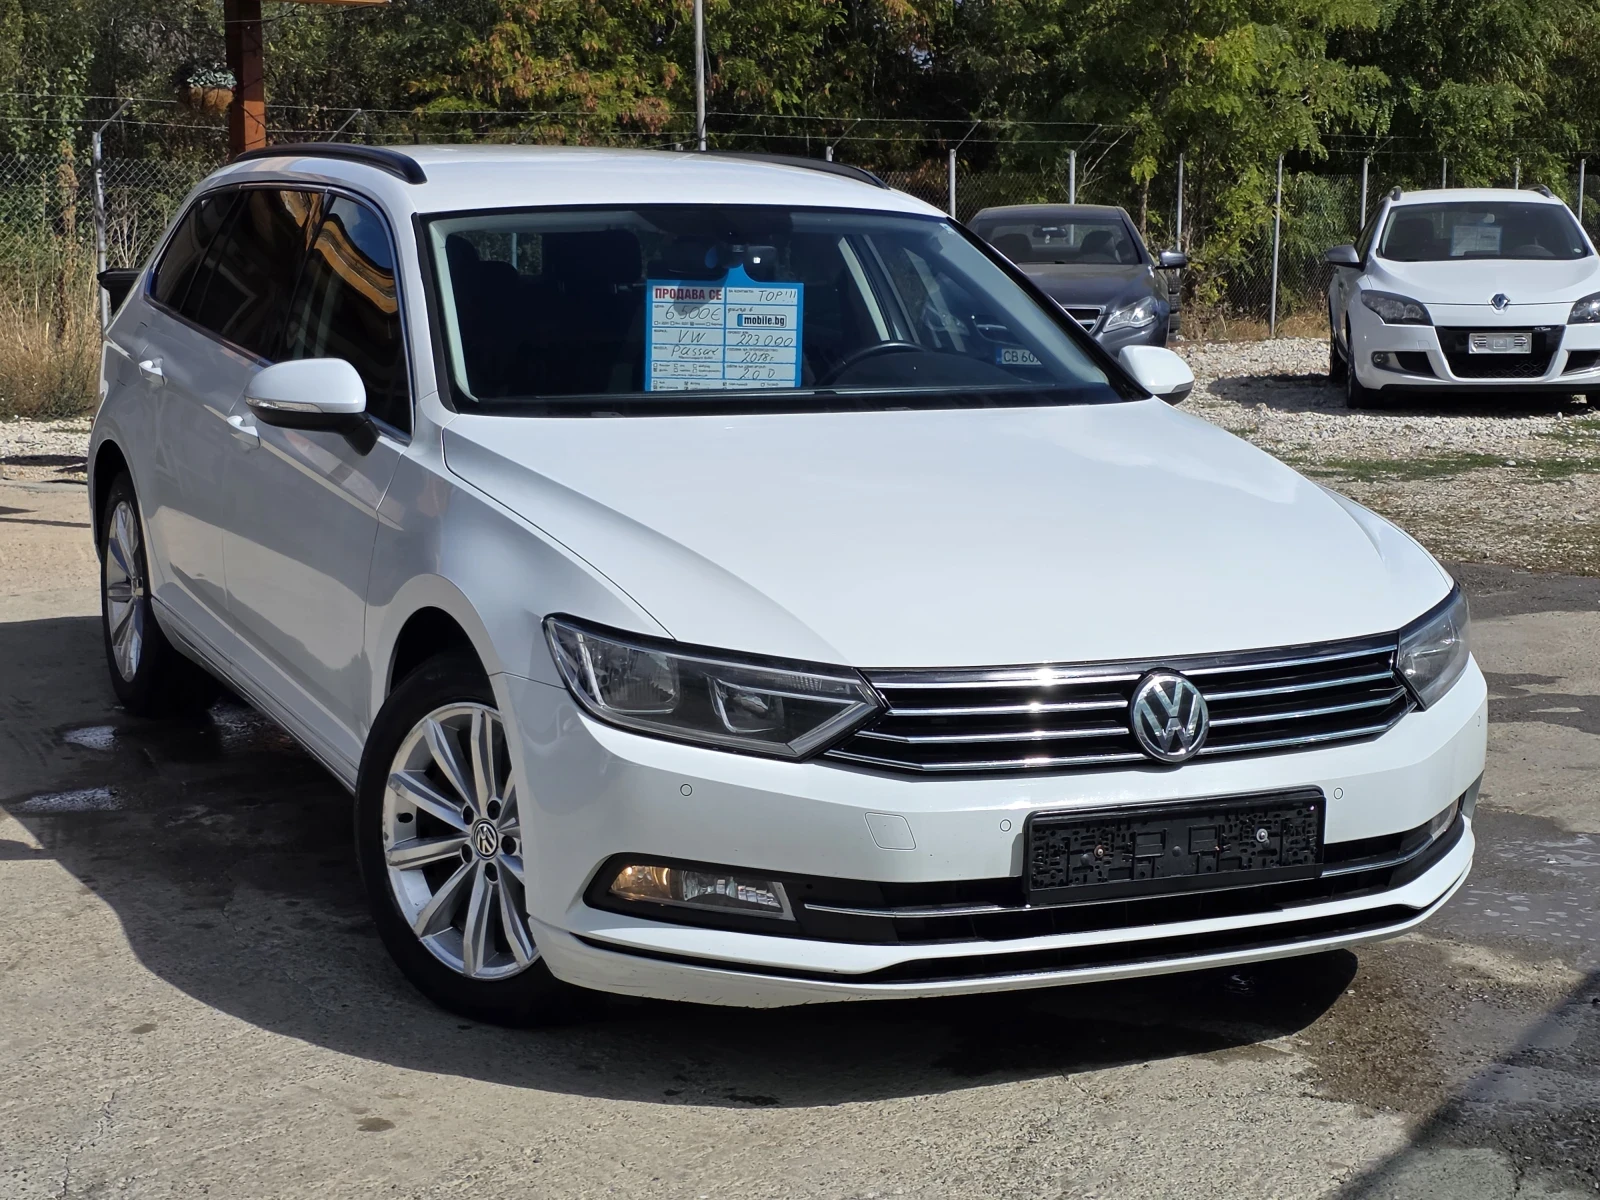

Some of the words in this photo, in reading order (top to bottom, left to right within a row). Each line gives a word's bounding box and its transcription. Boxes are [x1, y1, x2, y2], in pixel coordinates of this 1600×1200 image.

[655, 288, 705, 300] ПРОДАВА
[708, 289, 722, 300] СЕ
[743, 315, 785, 327] mobile.bg
[1021, 351, 1039, 363] 60
